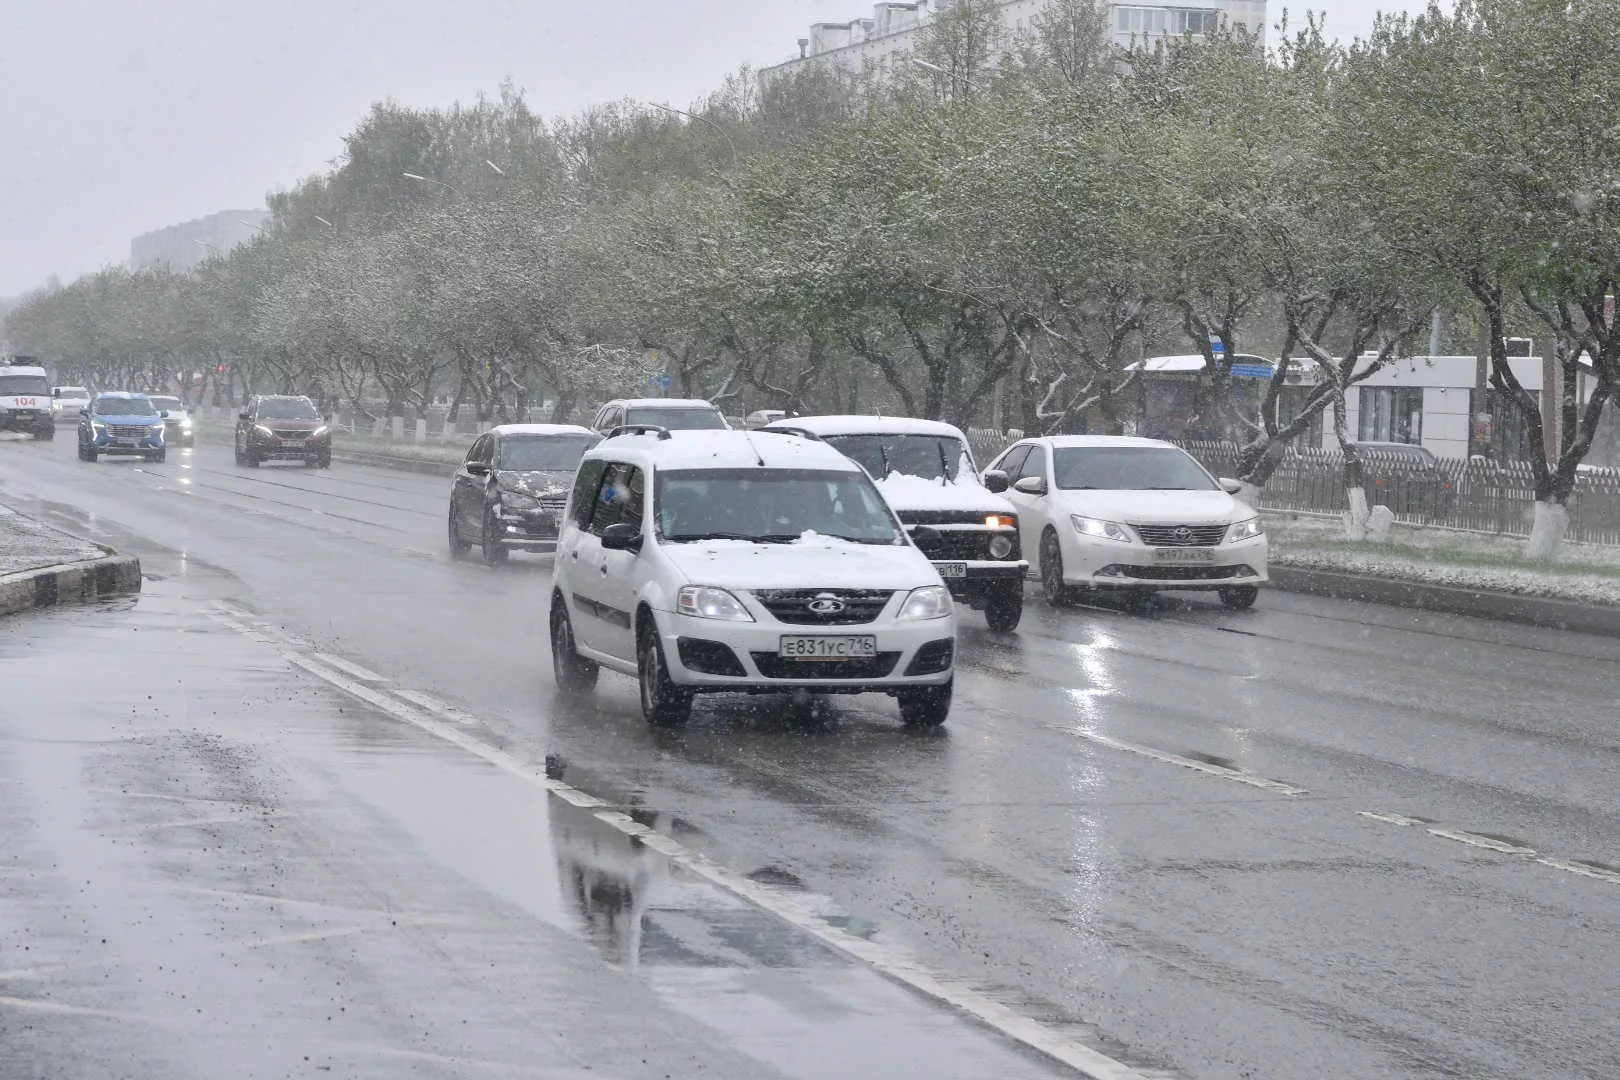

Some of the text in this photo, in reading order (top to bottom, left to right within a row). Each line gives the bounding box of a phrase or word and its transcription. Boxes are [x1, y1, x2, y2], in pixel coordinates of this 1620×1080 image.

[13, 397, 36, 406] 104
[948, 564, 963, 573] 116
[786, 639, 871, 654] Е831УС 716
